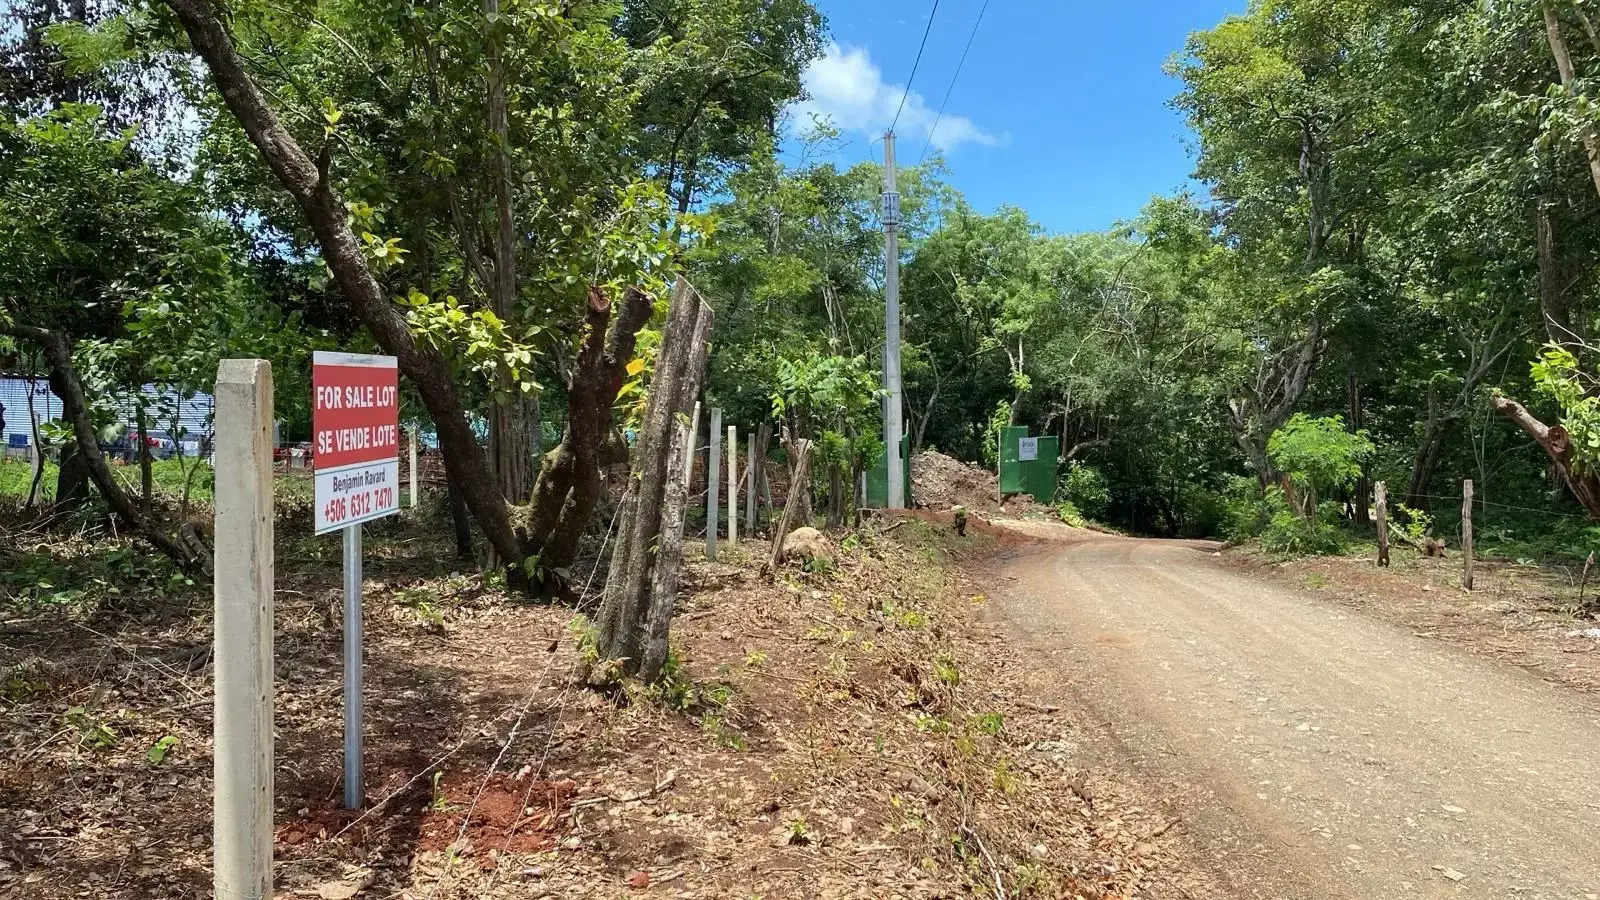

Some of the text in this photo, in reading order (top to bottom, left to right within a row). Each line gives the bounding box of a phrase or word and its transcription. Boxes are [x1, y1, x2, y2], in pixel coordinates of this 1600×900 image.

[317, 386, 395, 409] FOR SALE LOT
[318, 424, 395, 455] SE VENDE LOTE
[333, 468, 385, 494] Benjamin Ravard
[325, 487, 392, 523] +506 6312 7470
